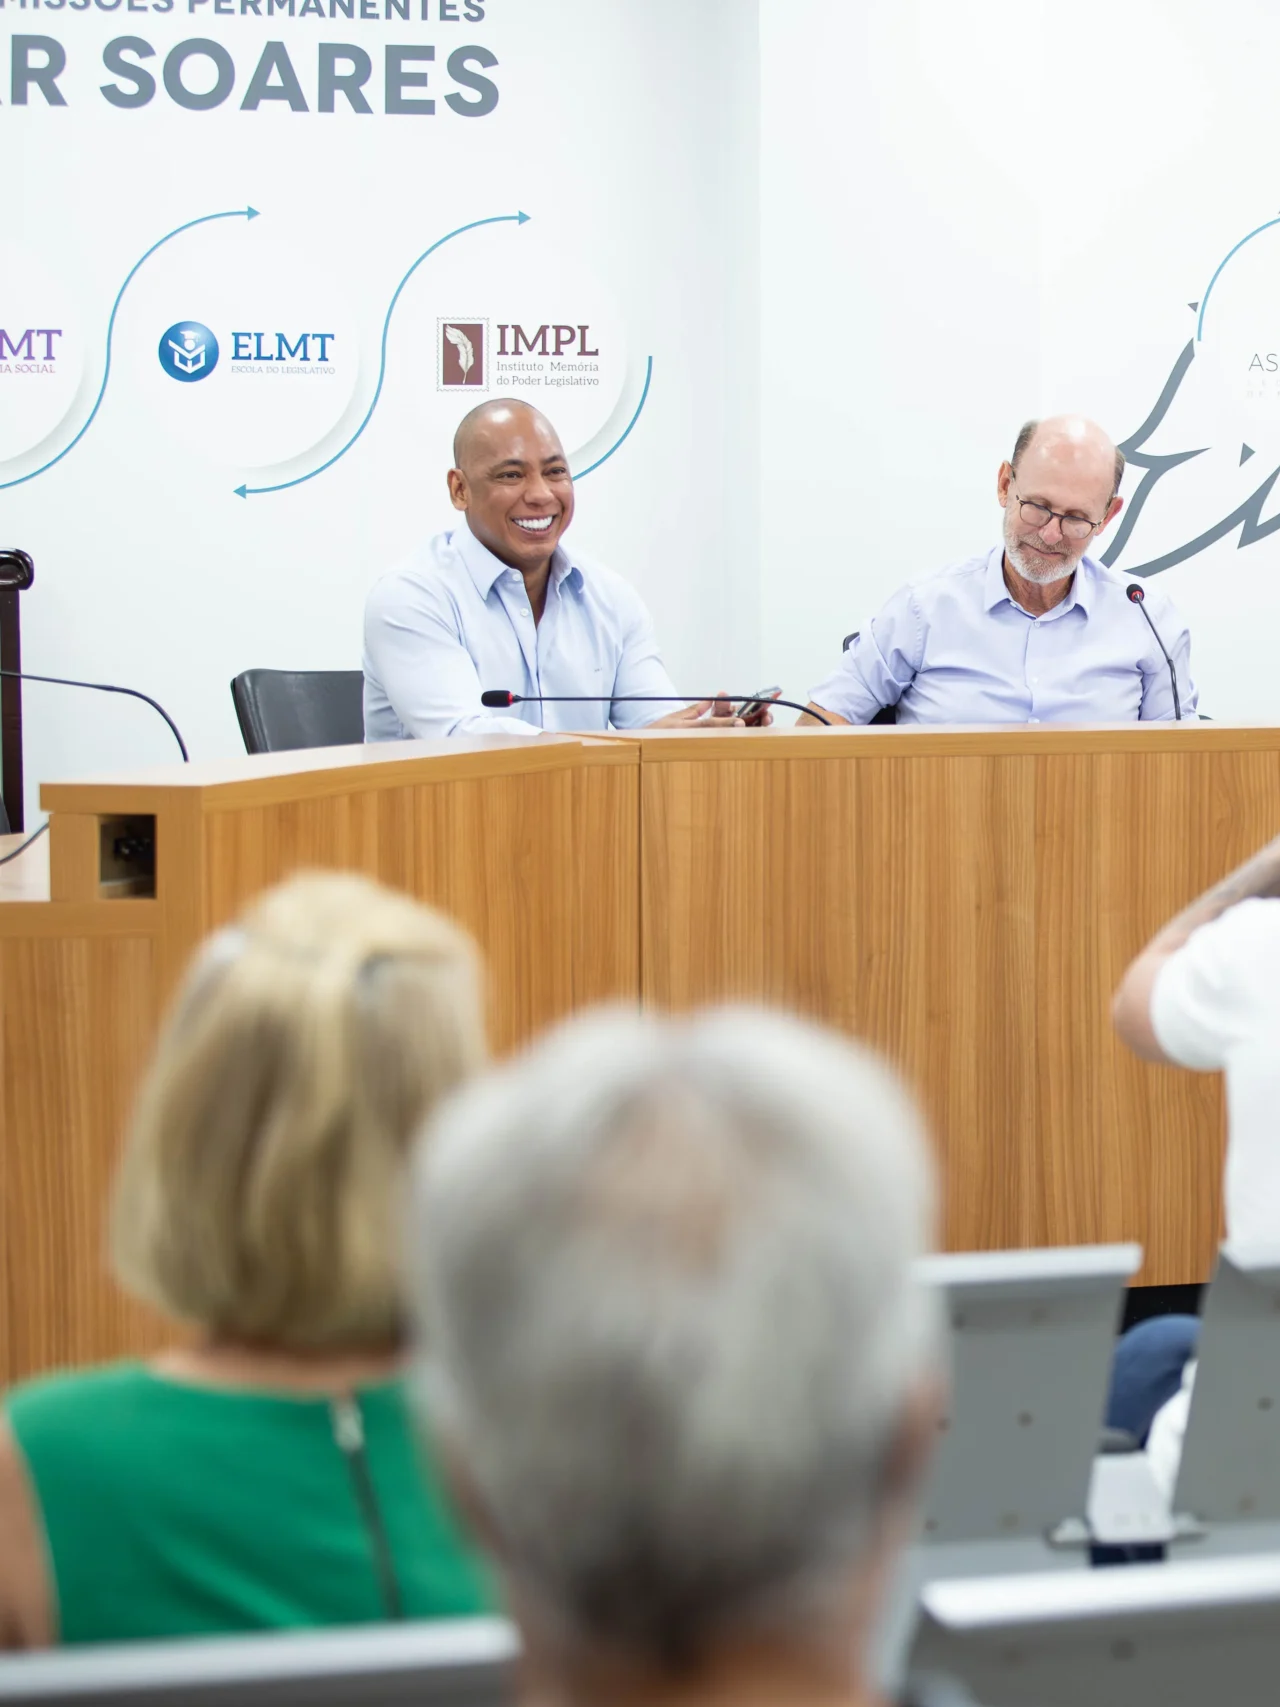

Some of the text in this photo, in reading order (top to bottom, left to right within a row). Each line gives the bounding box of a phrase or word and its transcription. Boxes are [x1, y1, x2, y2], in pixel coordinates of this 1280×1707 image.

[0, 35, 499, 117] R SOARES
[497, 325, 599, 356] IMPL
[231, 332, 335, 361] ELMT
[15, 364, 56, 374] SOCIAL
[231, 366, 336, 375] ESCOLA DO LEGISLATIVO
[497, 361, 599, 371] Instituto Memória
[497, 376, 600, 387] do Poder Legislativo
